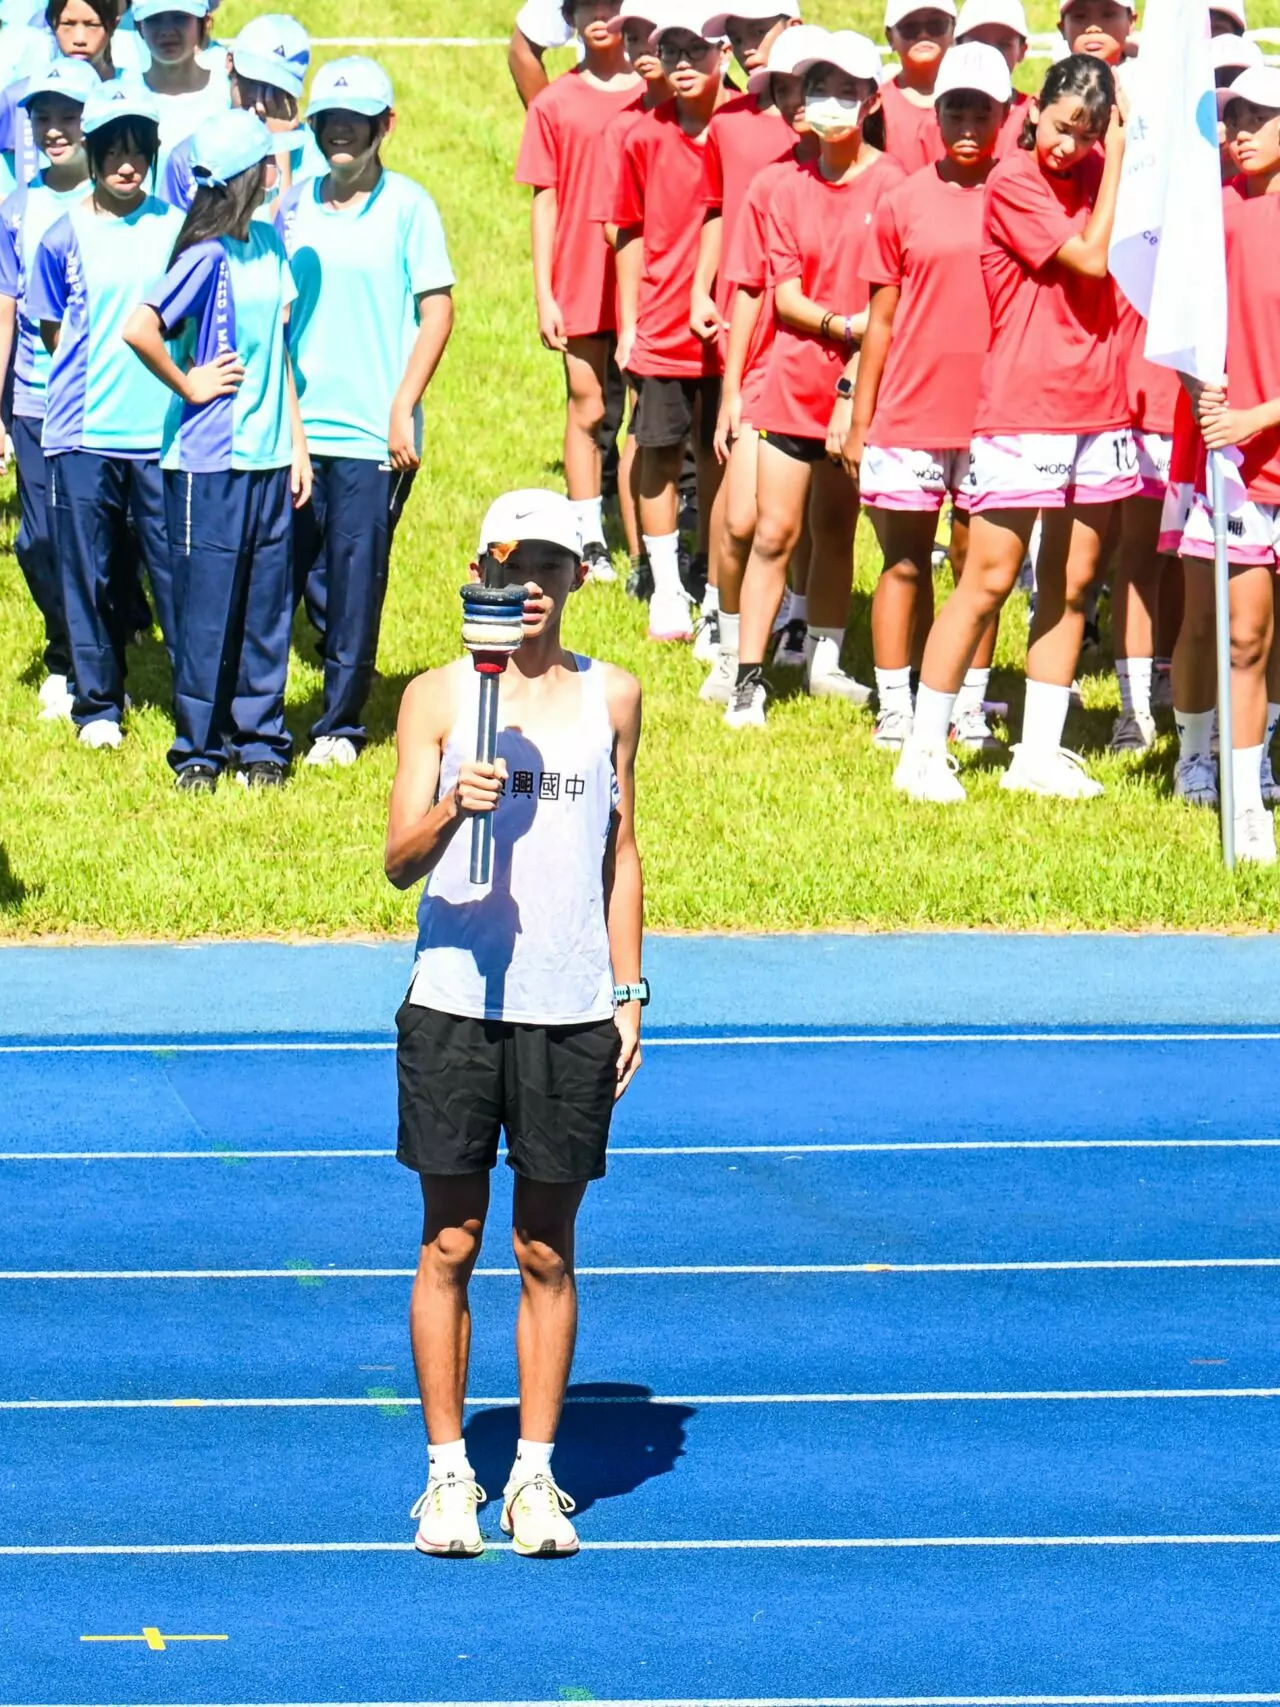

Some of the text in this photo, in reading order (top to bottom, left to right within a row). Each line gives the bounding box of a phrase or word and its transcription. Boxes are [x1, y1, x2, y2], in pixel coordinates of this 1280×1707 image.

[217, 328, 229, 353] MA
[500, 770, 585, 802] 興國中
